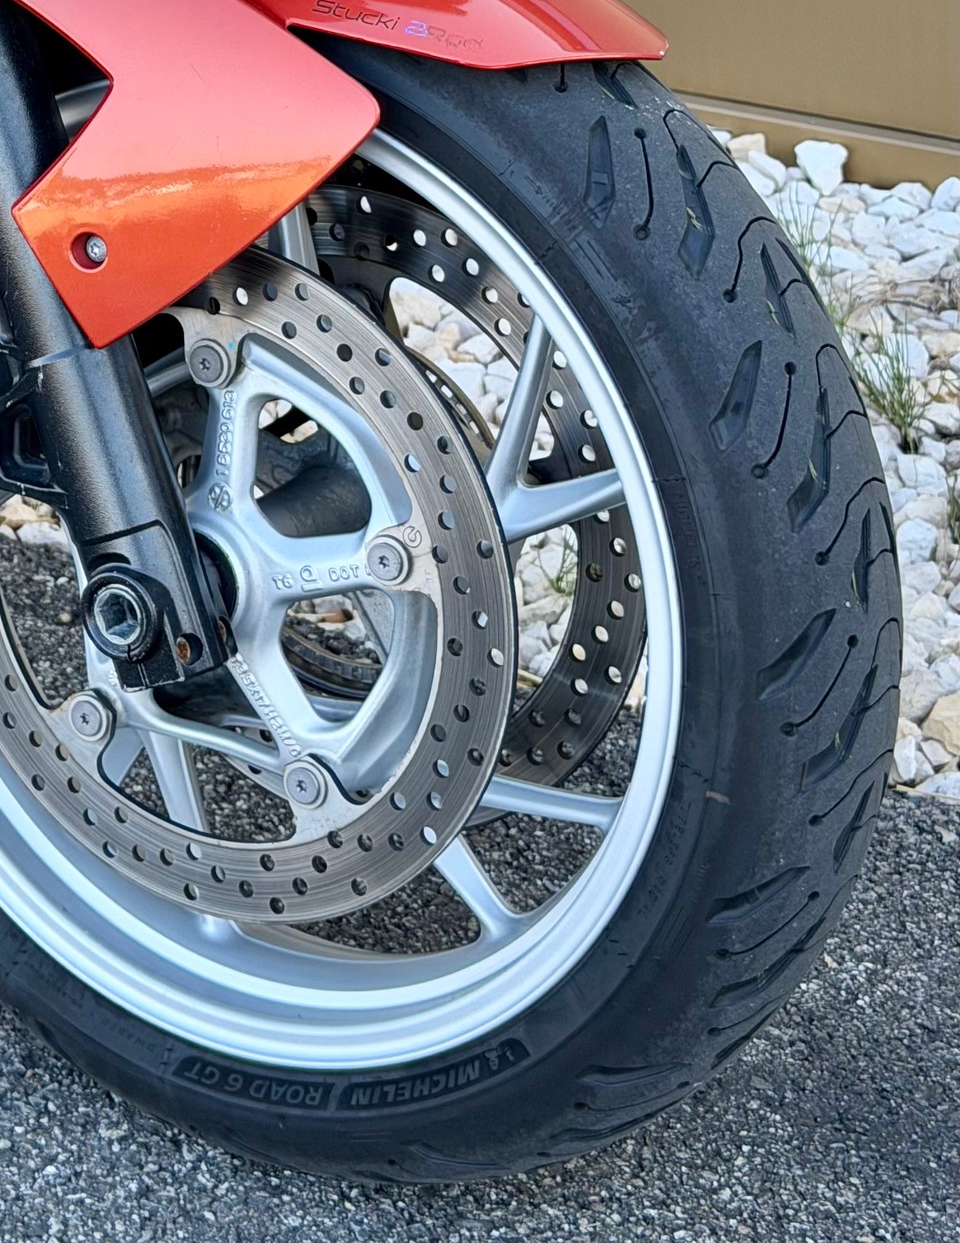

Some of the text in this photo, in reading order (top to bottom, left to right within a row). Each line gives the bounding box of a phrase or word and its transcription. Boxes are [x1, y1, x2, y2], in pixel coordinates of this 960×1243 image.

[312, 0, 401, 31] Stucki
[328, 564, 360, 582] DOT
[183, 1059, 482, 1106] MICHELIN ROAD 6 GT
